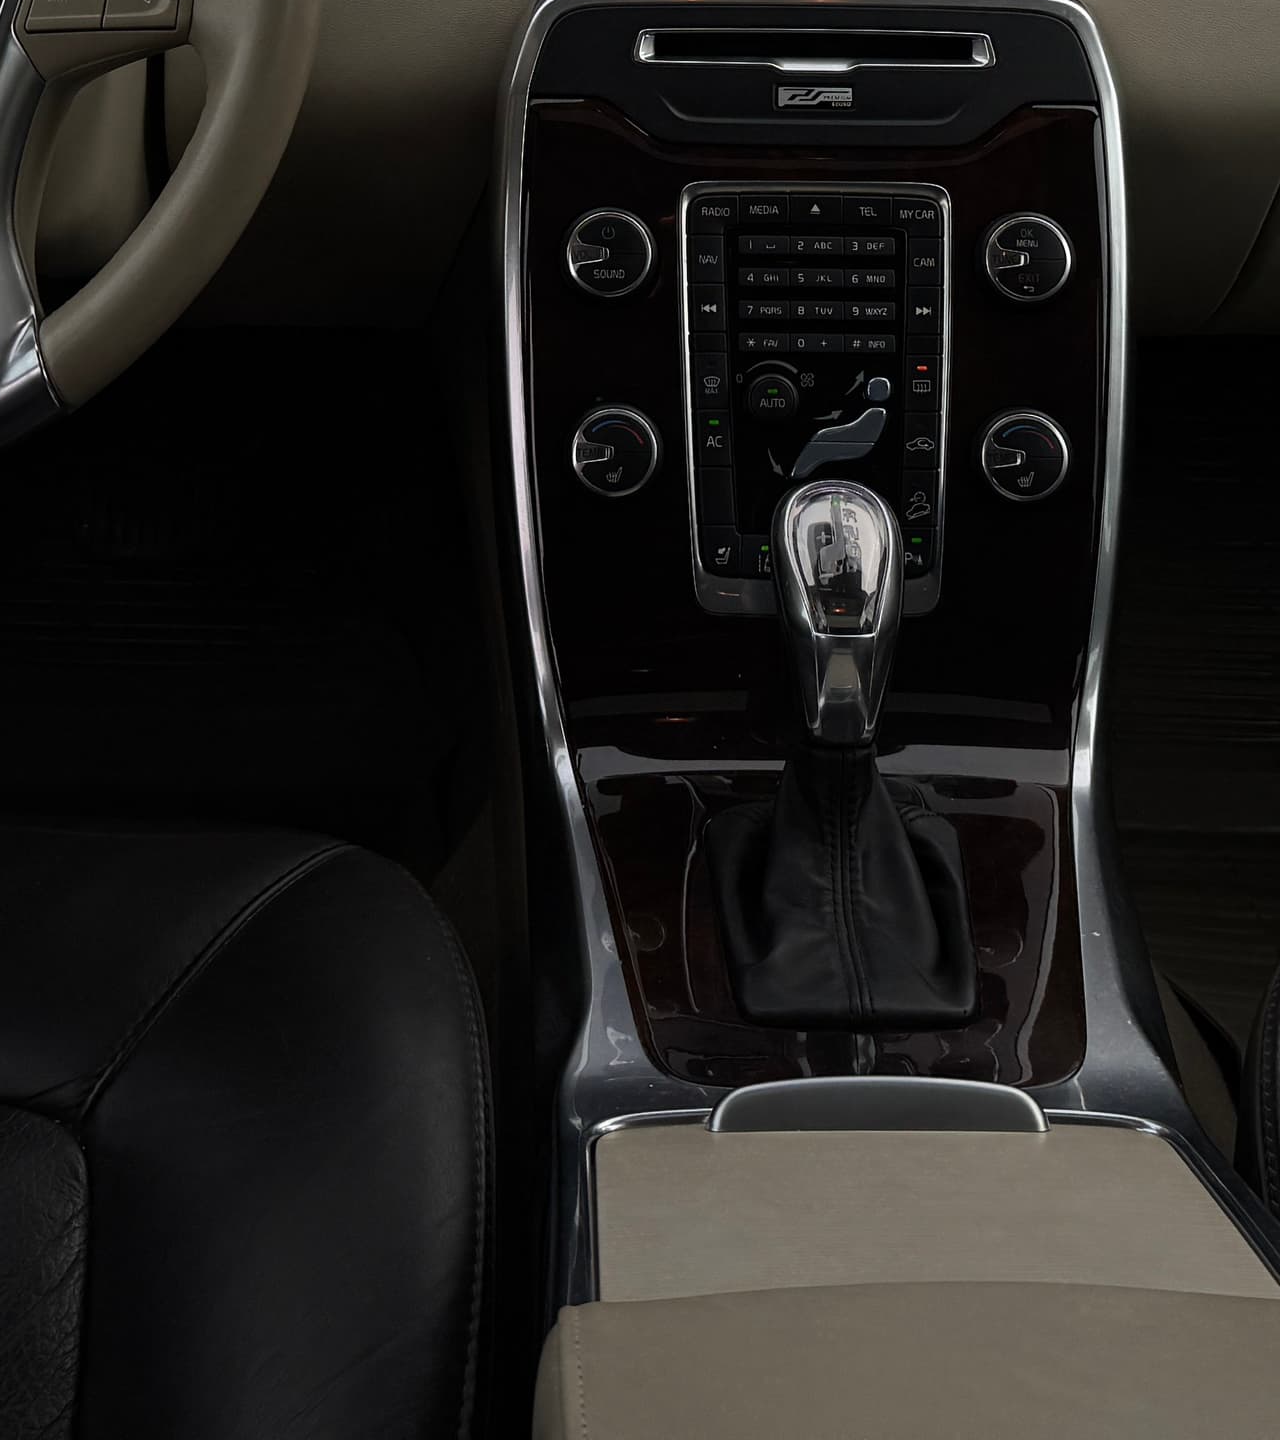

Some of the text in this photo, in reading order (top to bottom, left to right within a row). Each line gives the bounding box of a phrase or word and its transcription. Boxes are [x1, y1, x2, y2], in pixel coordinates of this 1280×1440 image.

[701, 206, 731, 217] RADIO
[749, 205, 780, 215] MEDIA
[859, 206, 877, 217] TEL
[899, 209, 935, 220] MY CAR
[1021, 228, 1033, 239] OK
[797, 240, 833, 250] 2 ABC
[851, 241, 885, 251] 3 DEF
[1016, 239, 1039, 248] MENU
[698, 254, 719, 264] NAV
[913, 257, 935, 268] CAM
[593, 269, 625, 279] SOUND
[746, 272, 779, 283] 4 GHI
[797, 273, 832, 283] 5 JKL
[851, 274, 886, 284] 6 MNO
[1018, 274, 1040, 284] EXIT
[746, 305, 782, 315] 7 PQRS
[797, 306, 833, 316] 8 TUV
[852, 306, 888, 316] 9 WXYZ
[797, 338, 805, 348] 0
[868, 340, 886, 349] INFO
[760, 398, 786, 408] AUTO
[706, 435, 724, 448] AC
